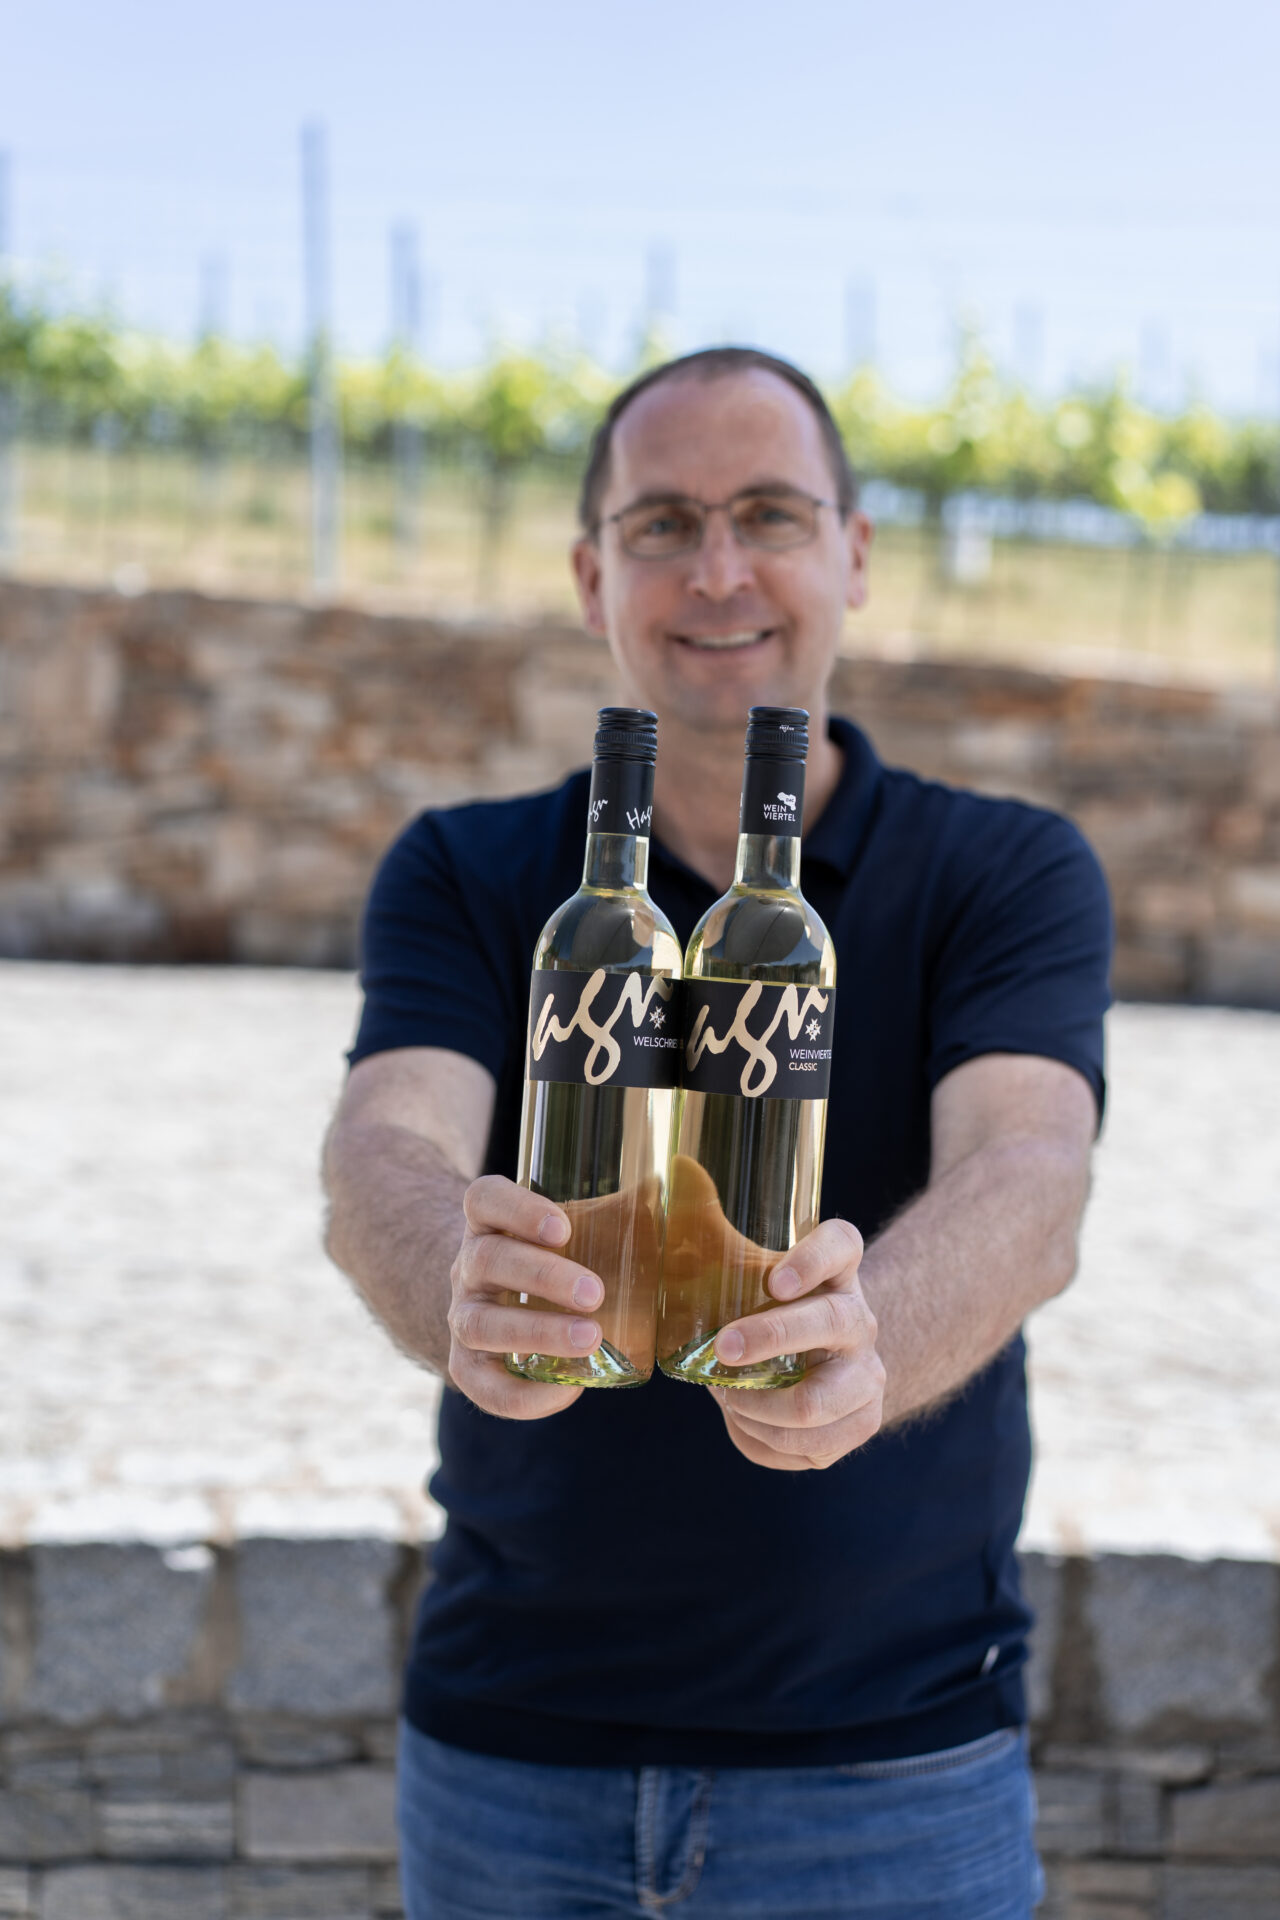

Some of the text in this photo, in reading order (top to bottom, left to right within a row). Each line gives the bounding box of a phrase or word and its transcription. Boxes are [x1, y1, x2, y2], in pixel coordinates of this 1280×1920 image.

[763, 803, 787, 813] WEIN
[763, 811, 796, 822] VIERTEL
[788, 1061, 818, 1072] CLASSIC
